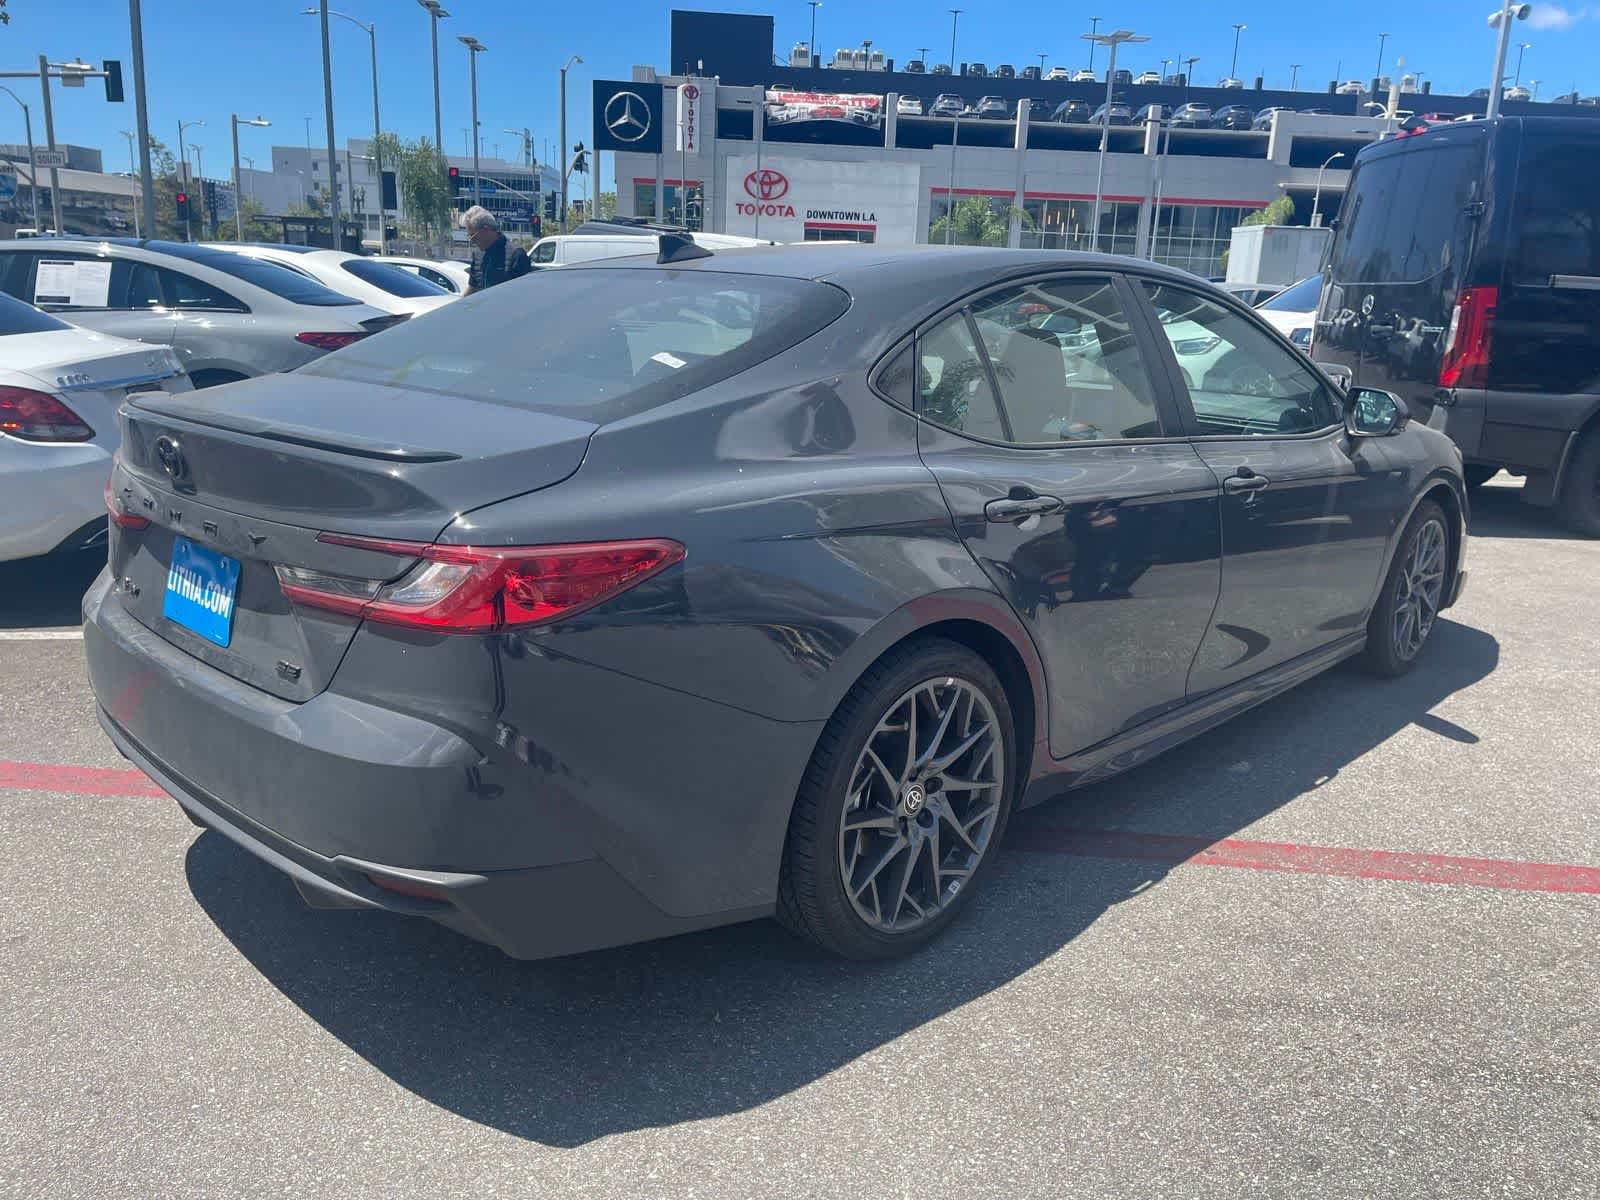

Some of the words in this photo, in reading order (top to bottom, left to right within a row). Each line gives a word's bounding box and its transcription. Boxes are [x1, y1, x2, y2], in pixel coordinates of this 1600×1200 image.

[687, 101, 695, 150] TOYOTA
[736, 203, 795, 217] TOYOTA
[806, 209, 860, 221] DOWNTOWN
[862, 212, 878, 222] L.A.
[167, 561, 233, 619] LITHIA.COM
